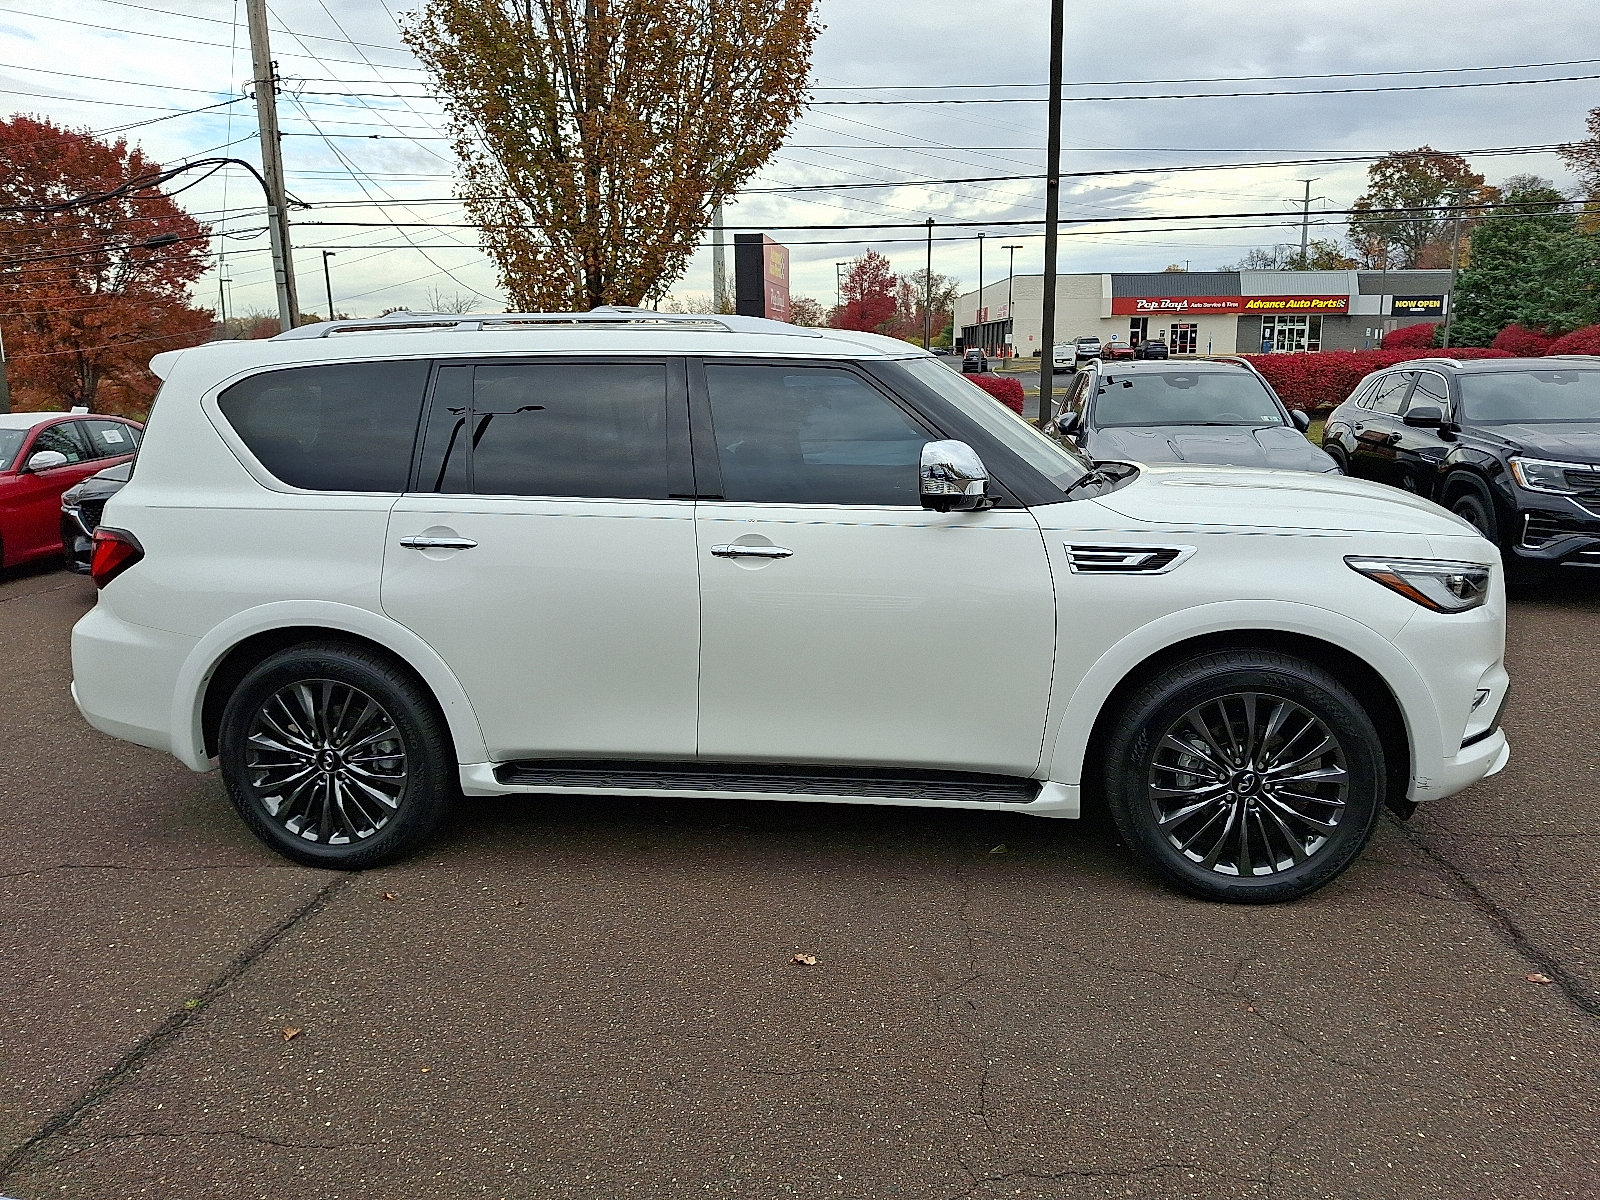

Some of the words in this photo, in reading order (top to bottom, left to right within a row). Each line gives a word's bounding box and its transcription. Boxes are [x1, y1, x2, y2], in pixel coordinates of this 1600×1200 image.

[1160, 299, 1189, 312] Boys
[1245, 299, 1286, 309] Advance
[1286, 299, 1311, 308] Auto
[1311, 299, 1338, 308] Parts
[1395, 300, 1417, 308] NOW
[1417, 300, 1441, 308] OPEN
